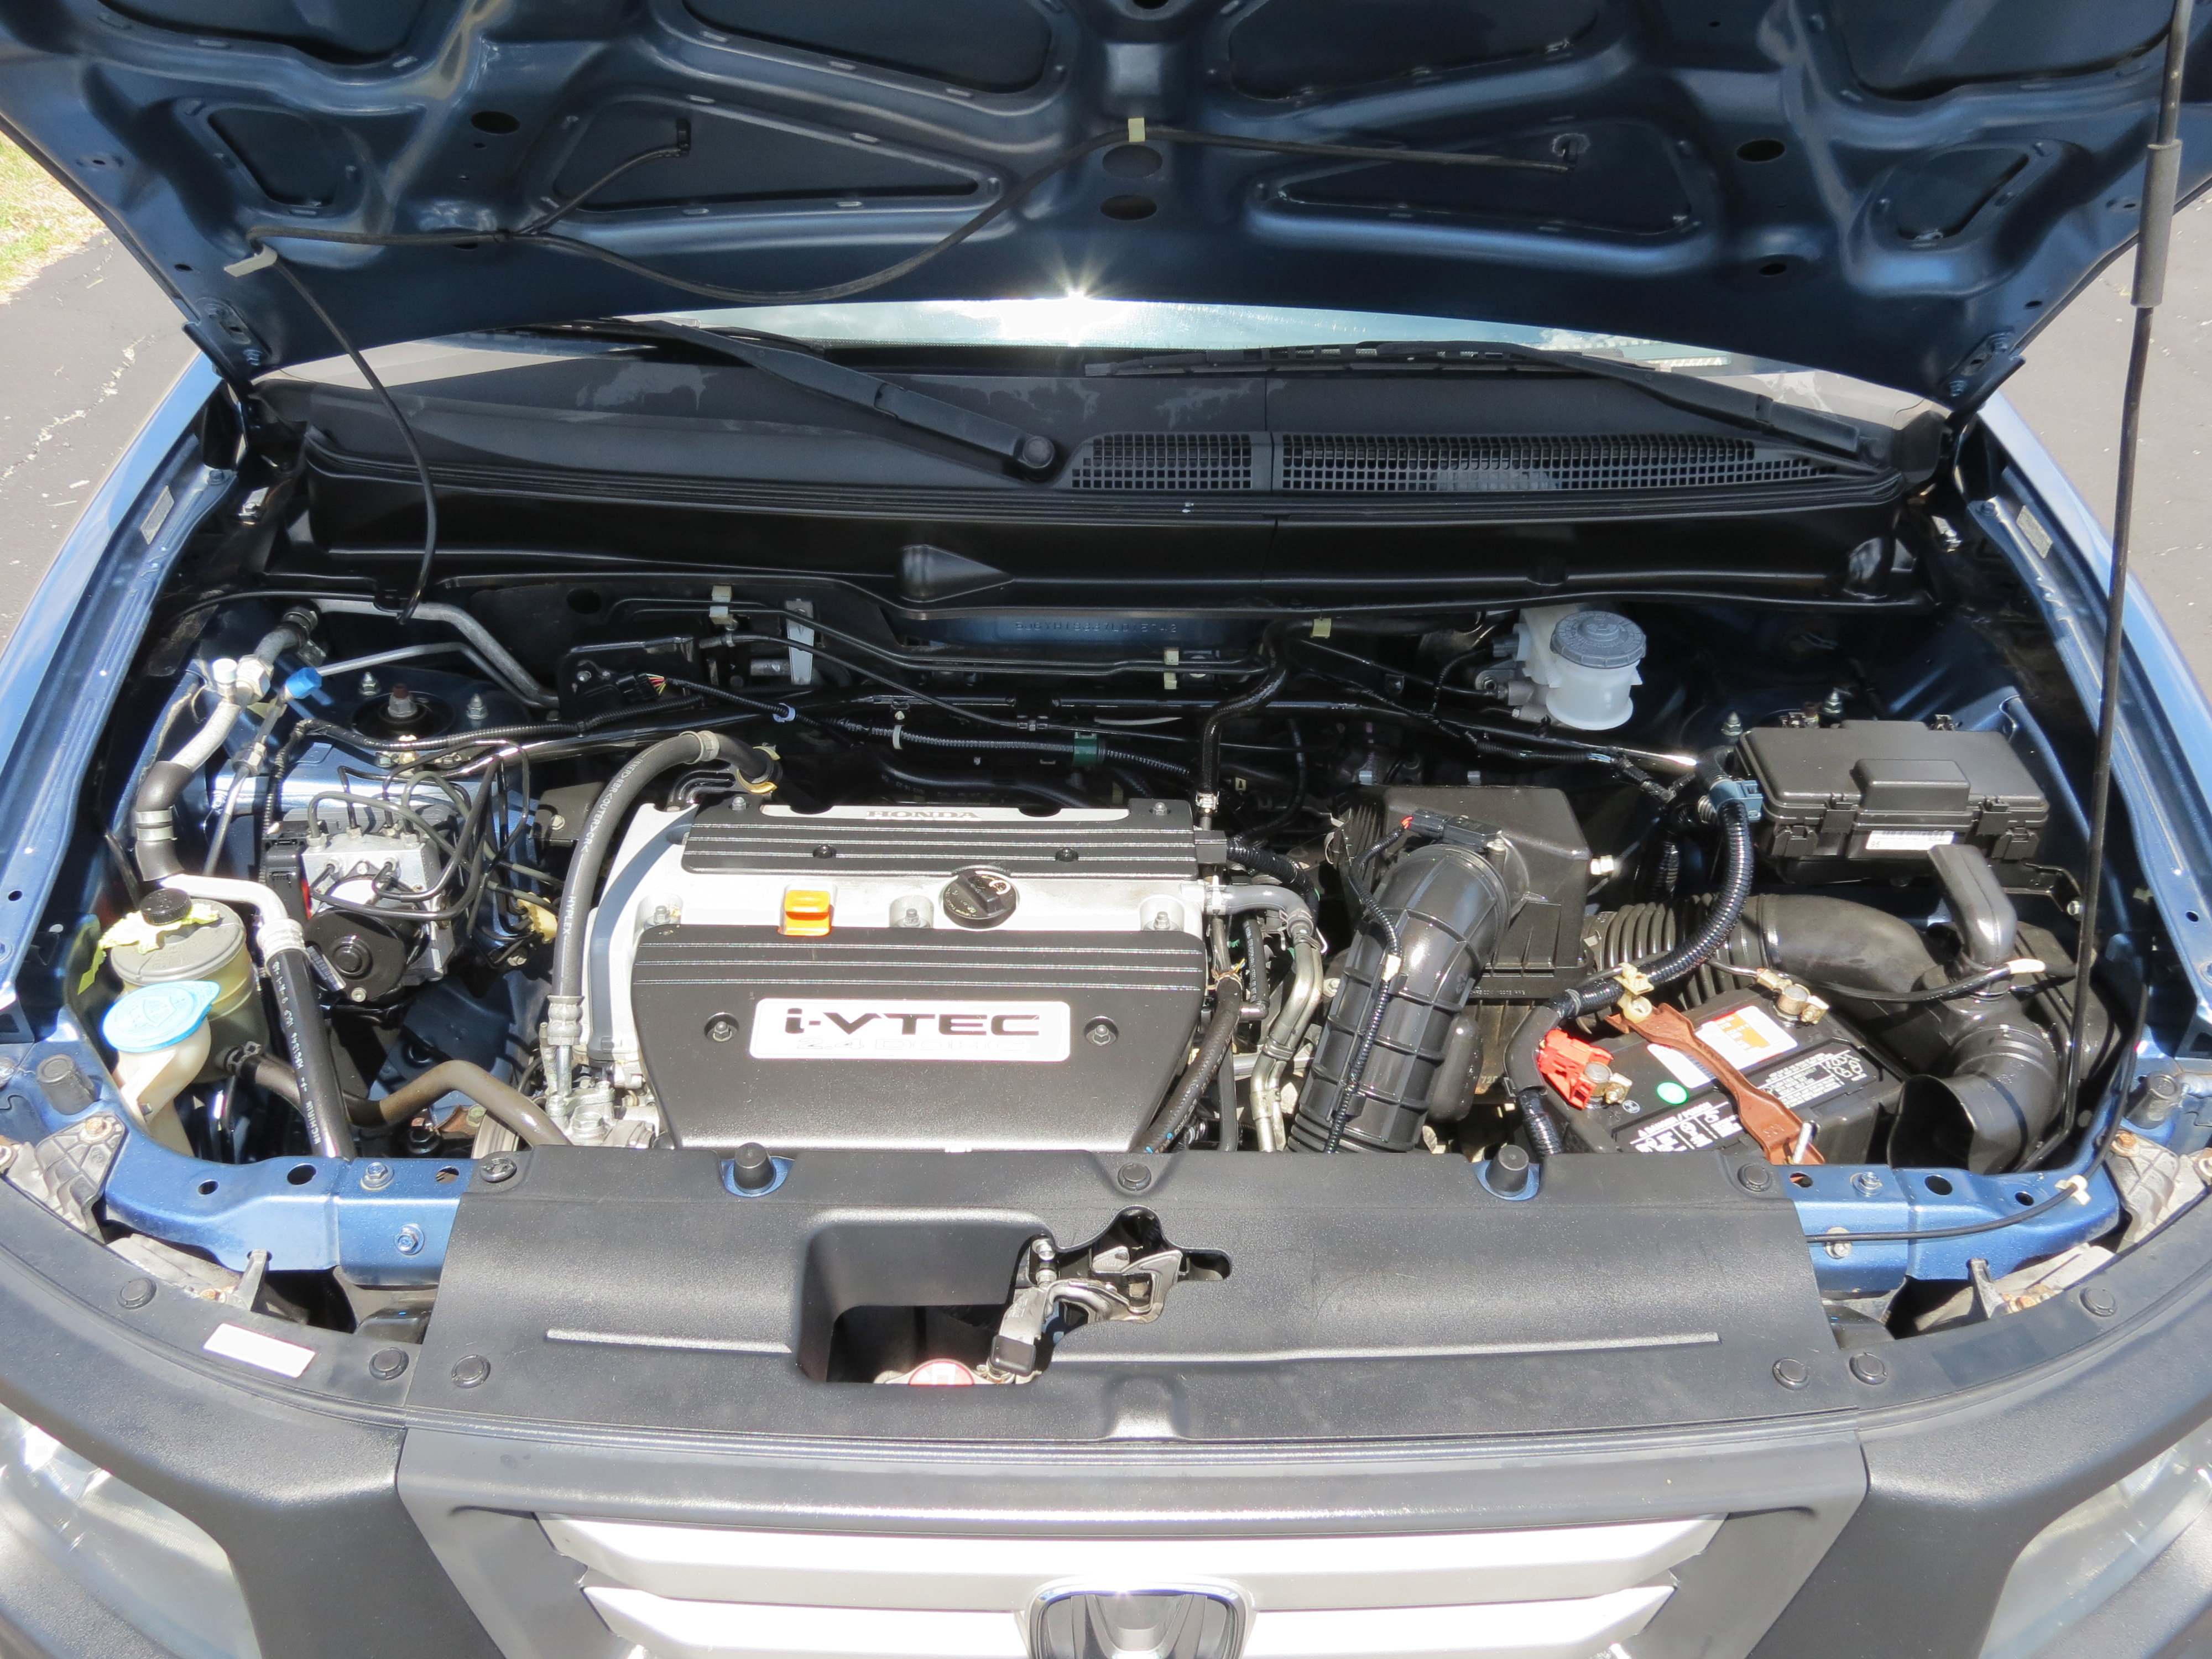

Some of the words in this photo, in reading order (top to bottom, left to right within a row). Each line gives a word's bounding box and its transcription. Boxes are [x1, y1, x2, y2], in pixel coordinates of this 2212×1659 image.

[865, 811, 982, 821] HONDA
[562, 897, 576, 936] HYPLEX
[784, 1007, 1040, 1035] i-VTEC
[797, 1037, 864, 1050] 2.4
